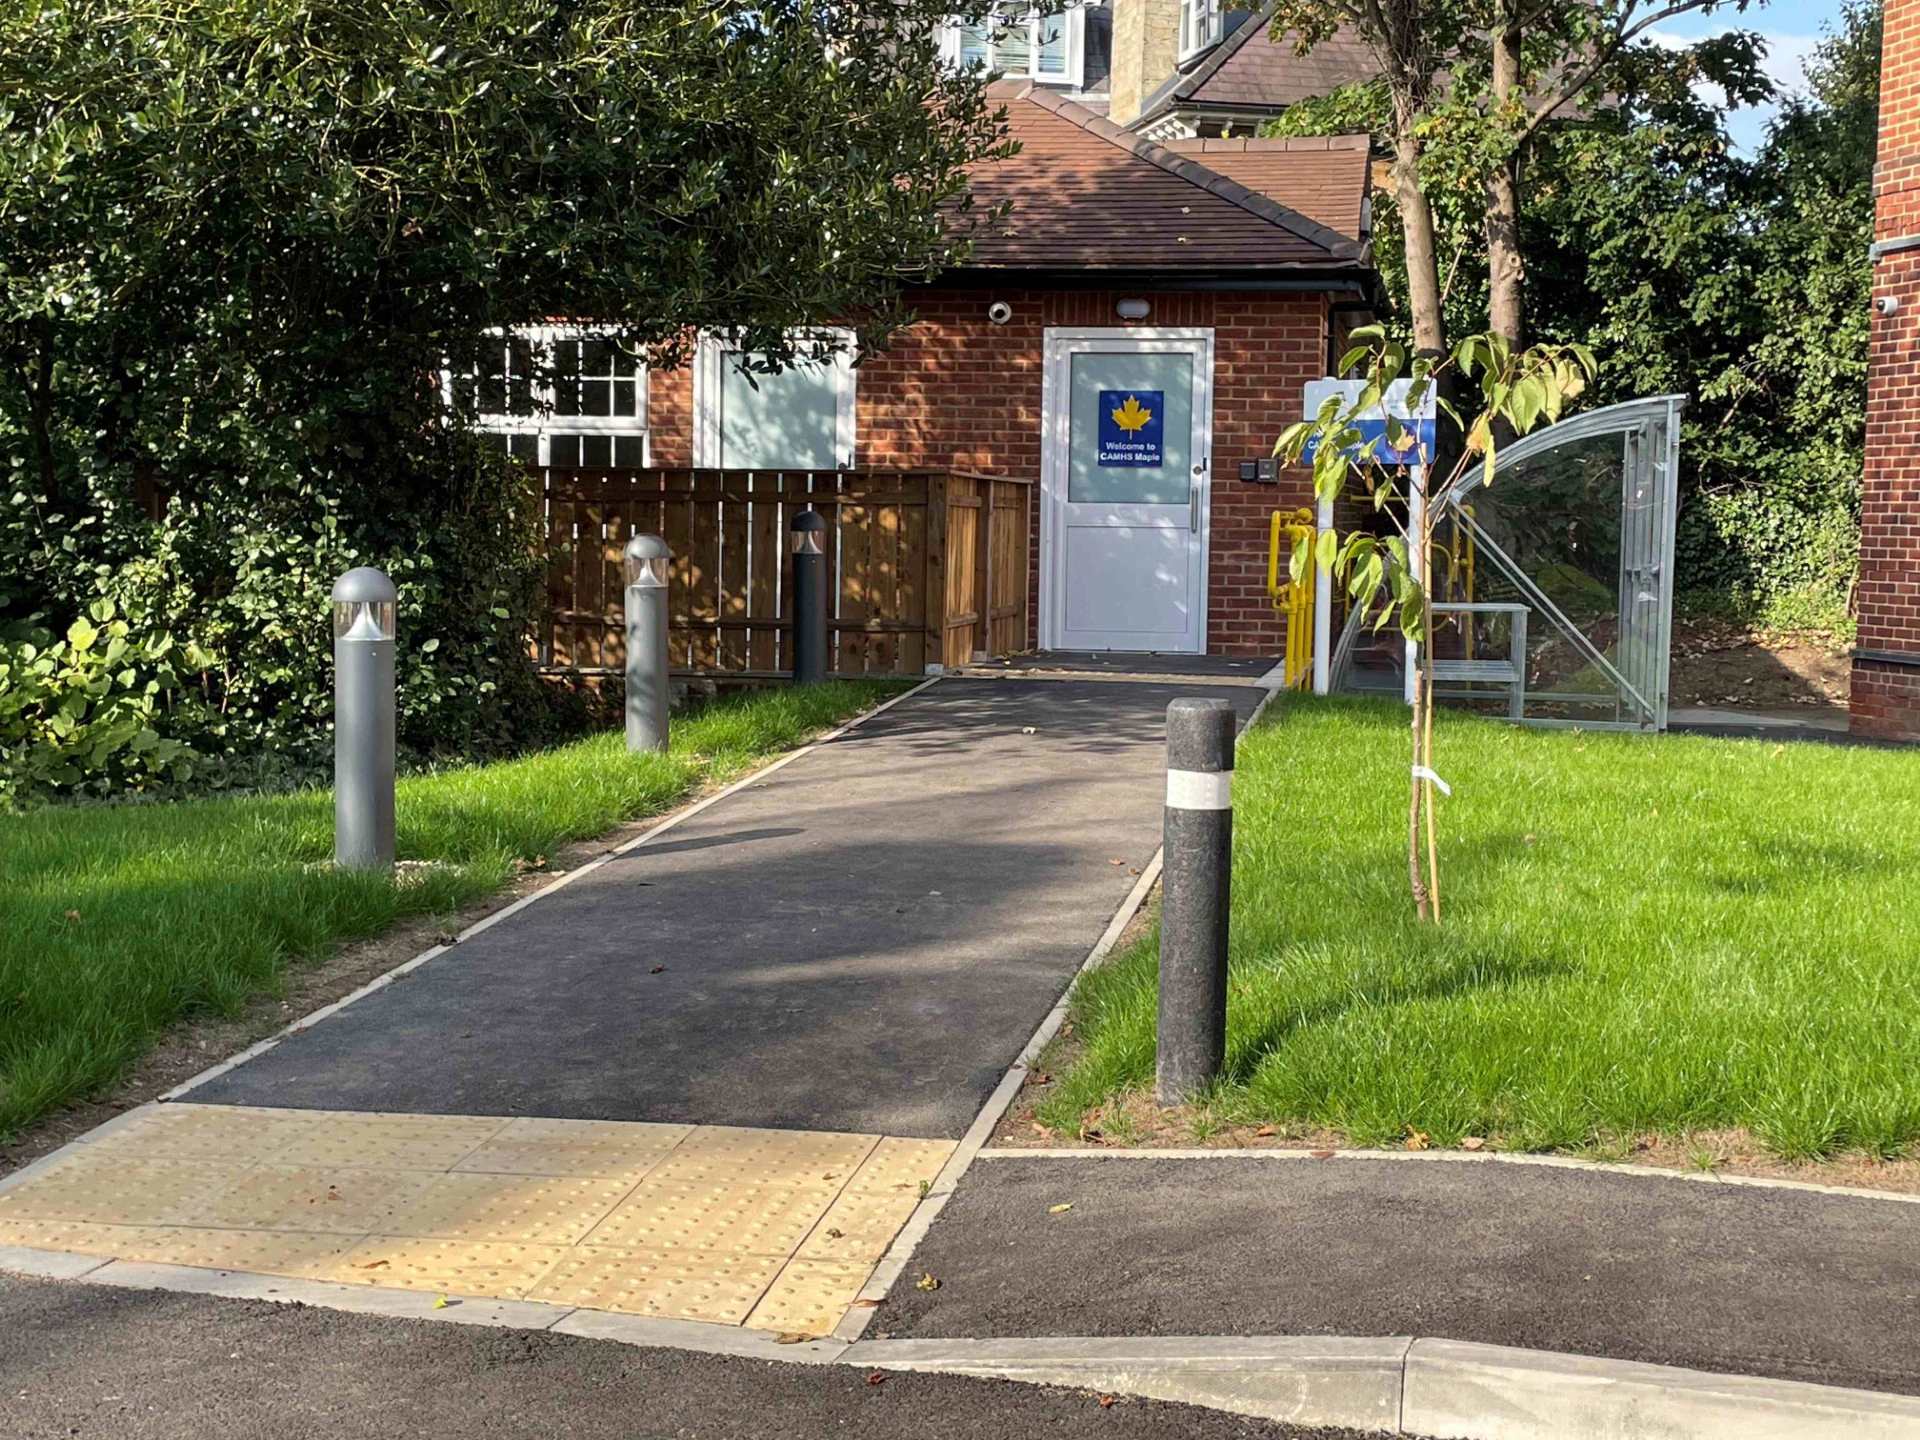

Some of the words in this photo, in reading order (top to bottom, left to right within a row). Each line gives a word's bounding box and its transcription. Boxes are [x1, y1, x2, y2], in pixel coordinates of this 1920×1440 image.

[1105, 442, 1145, 450] Welcome
[1100, 452, 1133, 460] CAMHS
[1135, 452, 1160, 462] Maple
